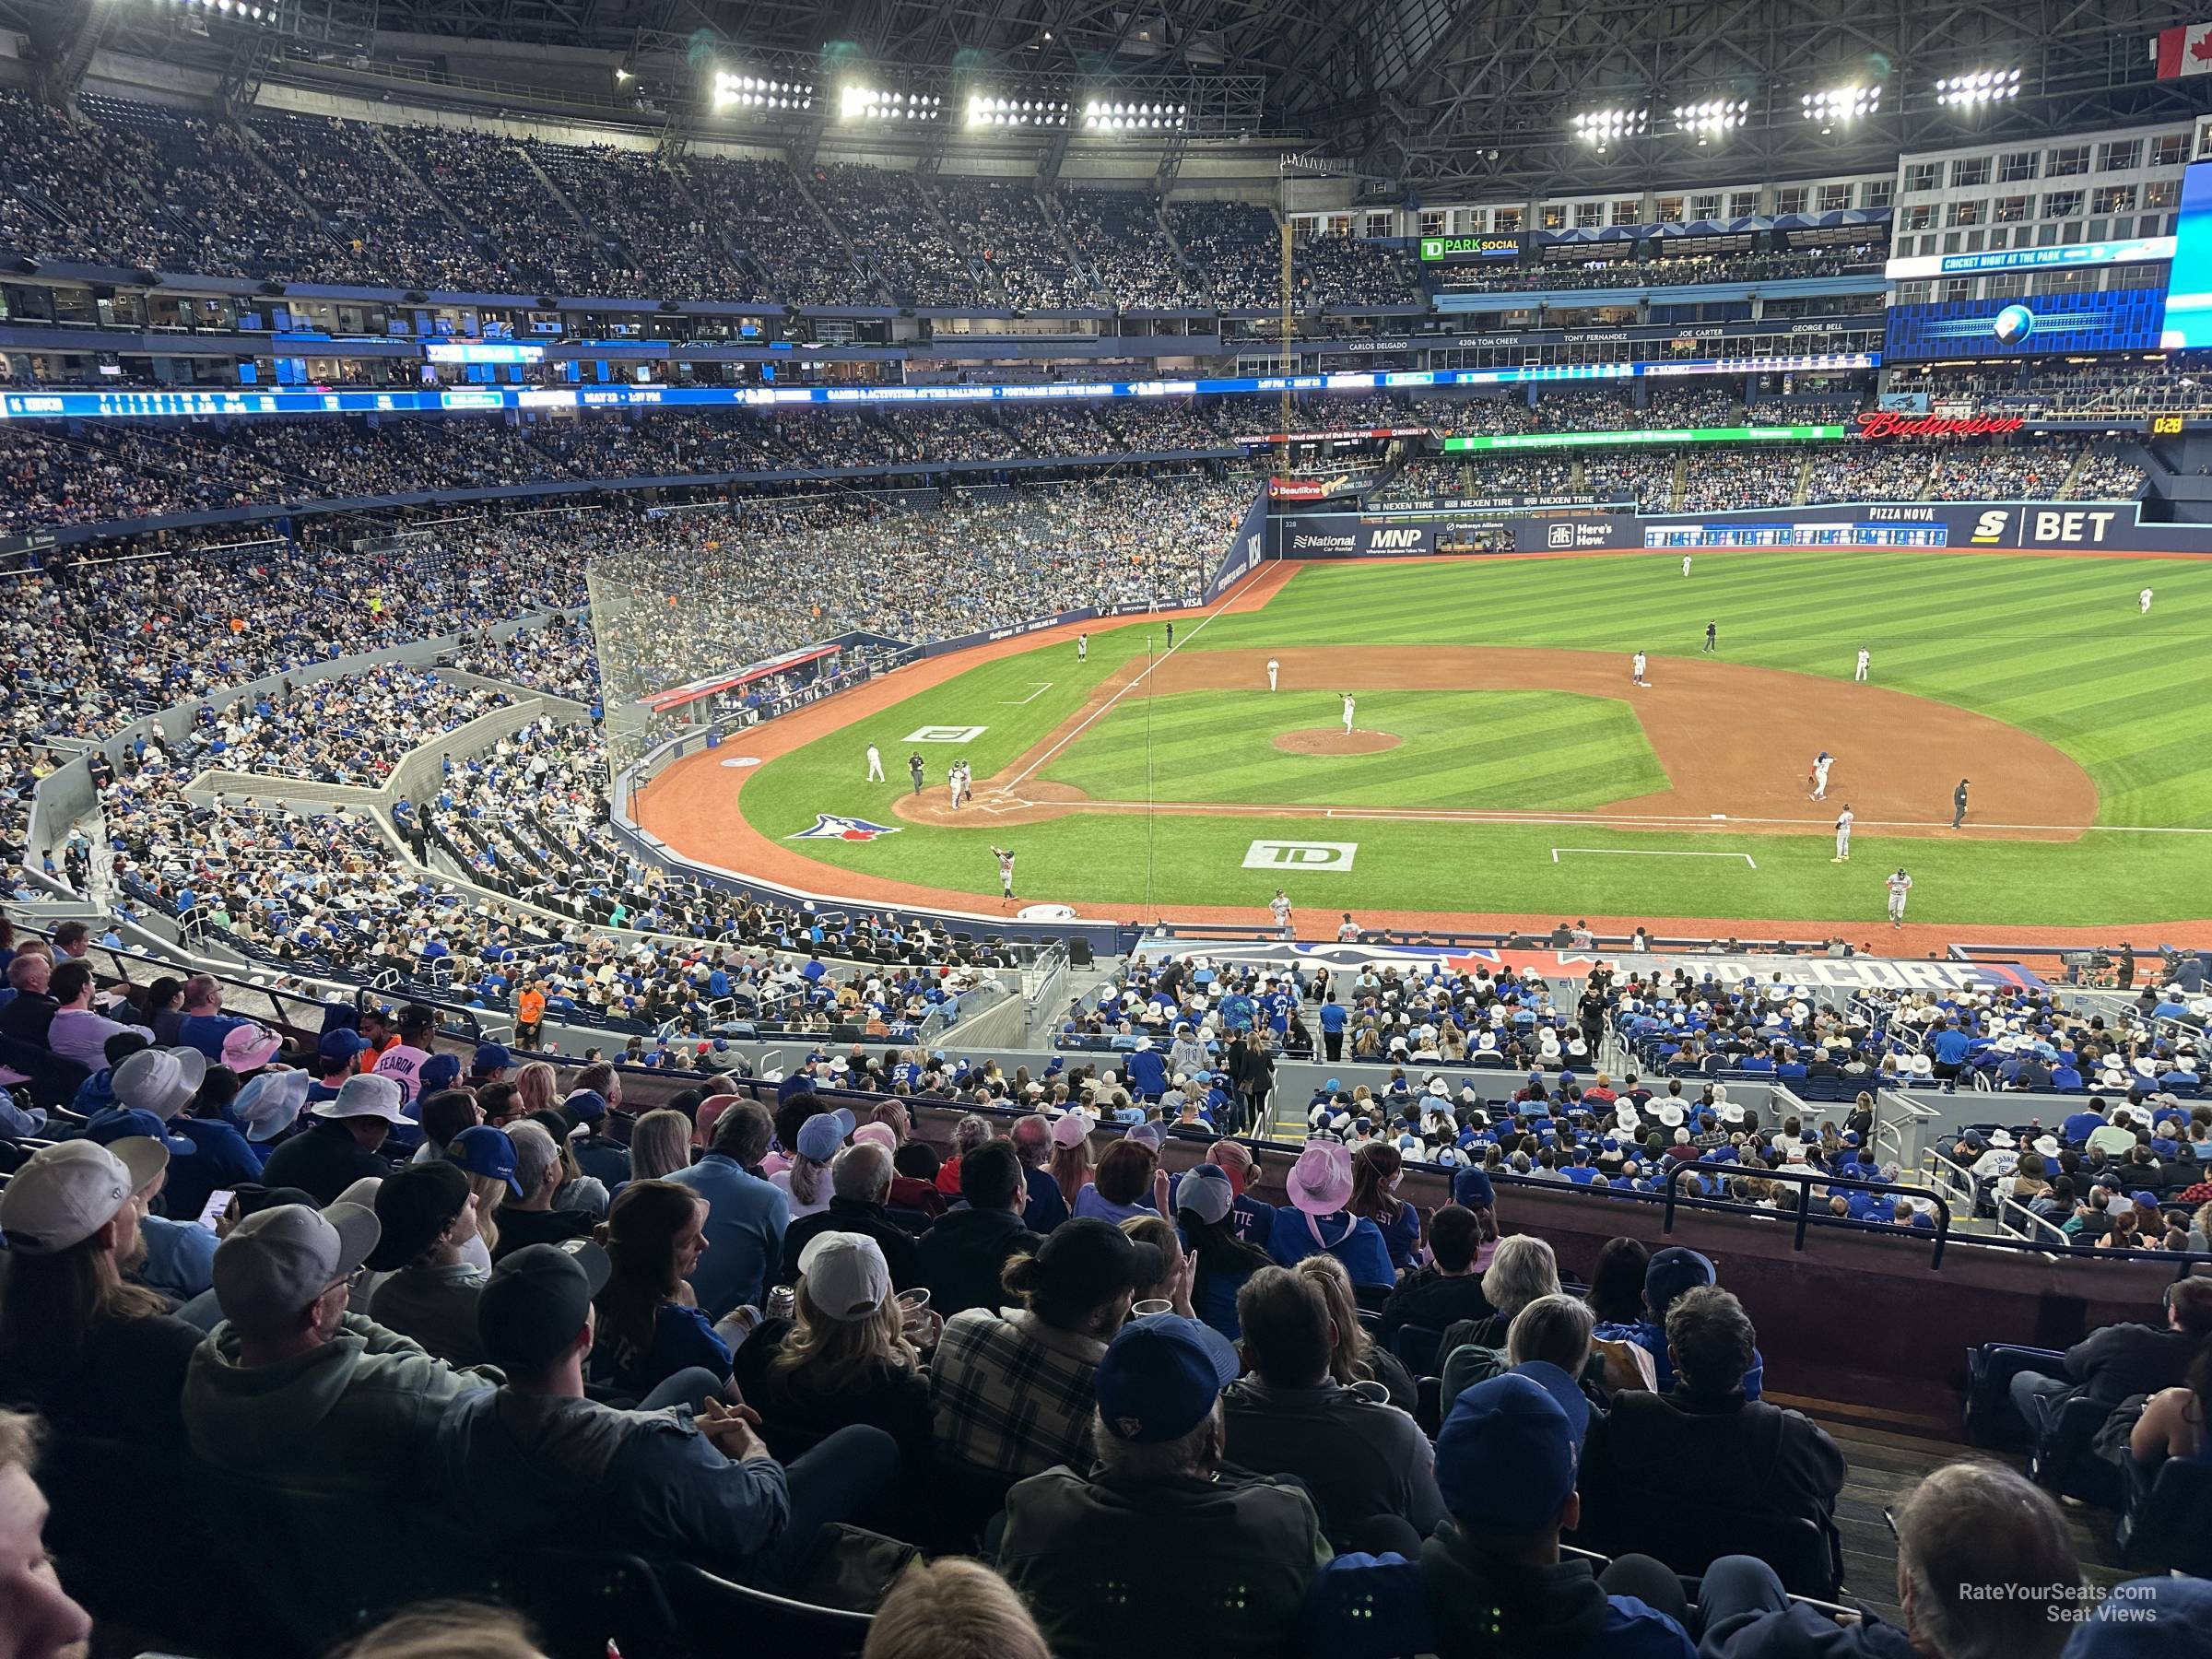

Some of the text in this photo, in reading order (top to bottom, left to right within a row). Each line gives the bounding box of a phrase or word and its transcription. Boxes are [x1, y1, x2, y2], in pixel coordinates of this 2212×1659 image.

[1423, 239, 1519, 256] TD PARK SOCIAL
[1945, 257, 1979, 270] CRICKET
[1981, 254, 2006, 267] NIGHT
[2007, 253, 2017, 265] AT
[2018, 252, 2035, 265] THE
[2037, 250, 2060, 263] PARK
[1826, 323, 1842, 331] BELL
[1586, 333, 1628, 341] FERNANDEZ
[1349, 341, 1407, 351] CARLOS DELGADO
[1857, 412, 2025, 438] Budweiser
[1358, 430, 1372, 439] Jays
[1460, 500, 1488, 508] NEXEN
[1489, 498, 1513, 506] TIRE
[1540, 497, 1569, 505] NEXEN
[1571, 496, 1594, 504] TIRE
[1869, 507, 1934, 521] PIZZA NOVA
[1577, 524, 1612, 535] Here's
[2035, 512, 2115, 542] BET
[1371, 530, 1422, 547] MNP
[1577, 535, 1606, 546] How.
[1182, 598, 1202, 608] VISA
[1263, 846, 1342, 864] TD
[1684, 961, 1752, 984] TO
[1807, 959, 1994, 991] CORE
[1276, 1004, 1288, 1017] 27
[1185, 1048, 1197, 1061] 11
[380, 1056, 416, 1075] FEARON
[893, 1068, 909, 1080] 55
